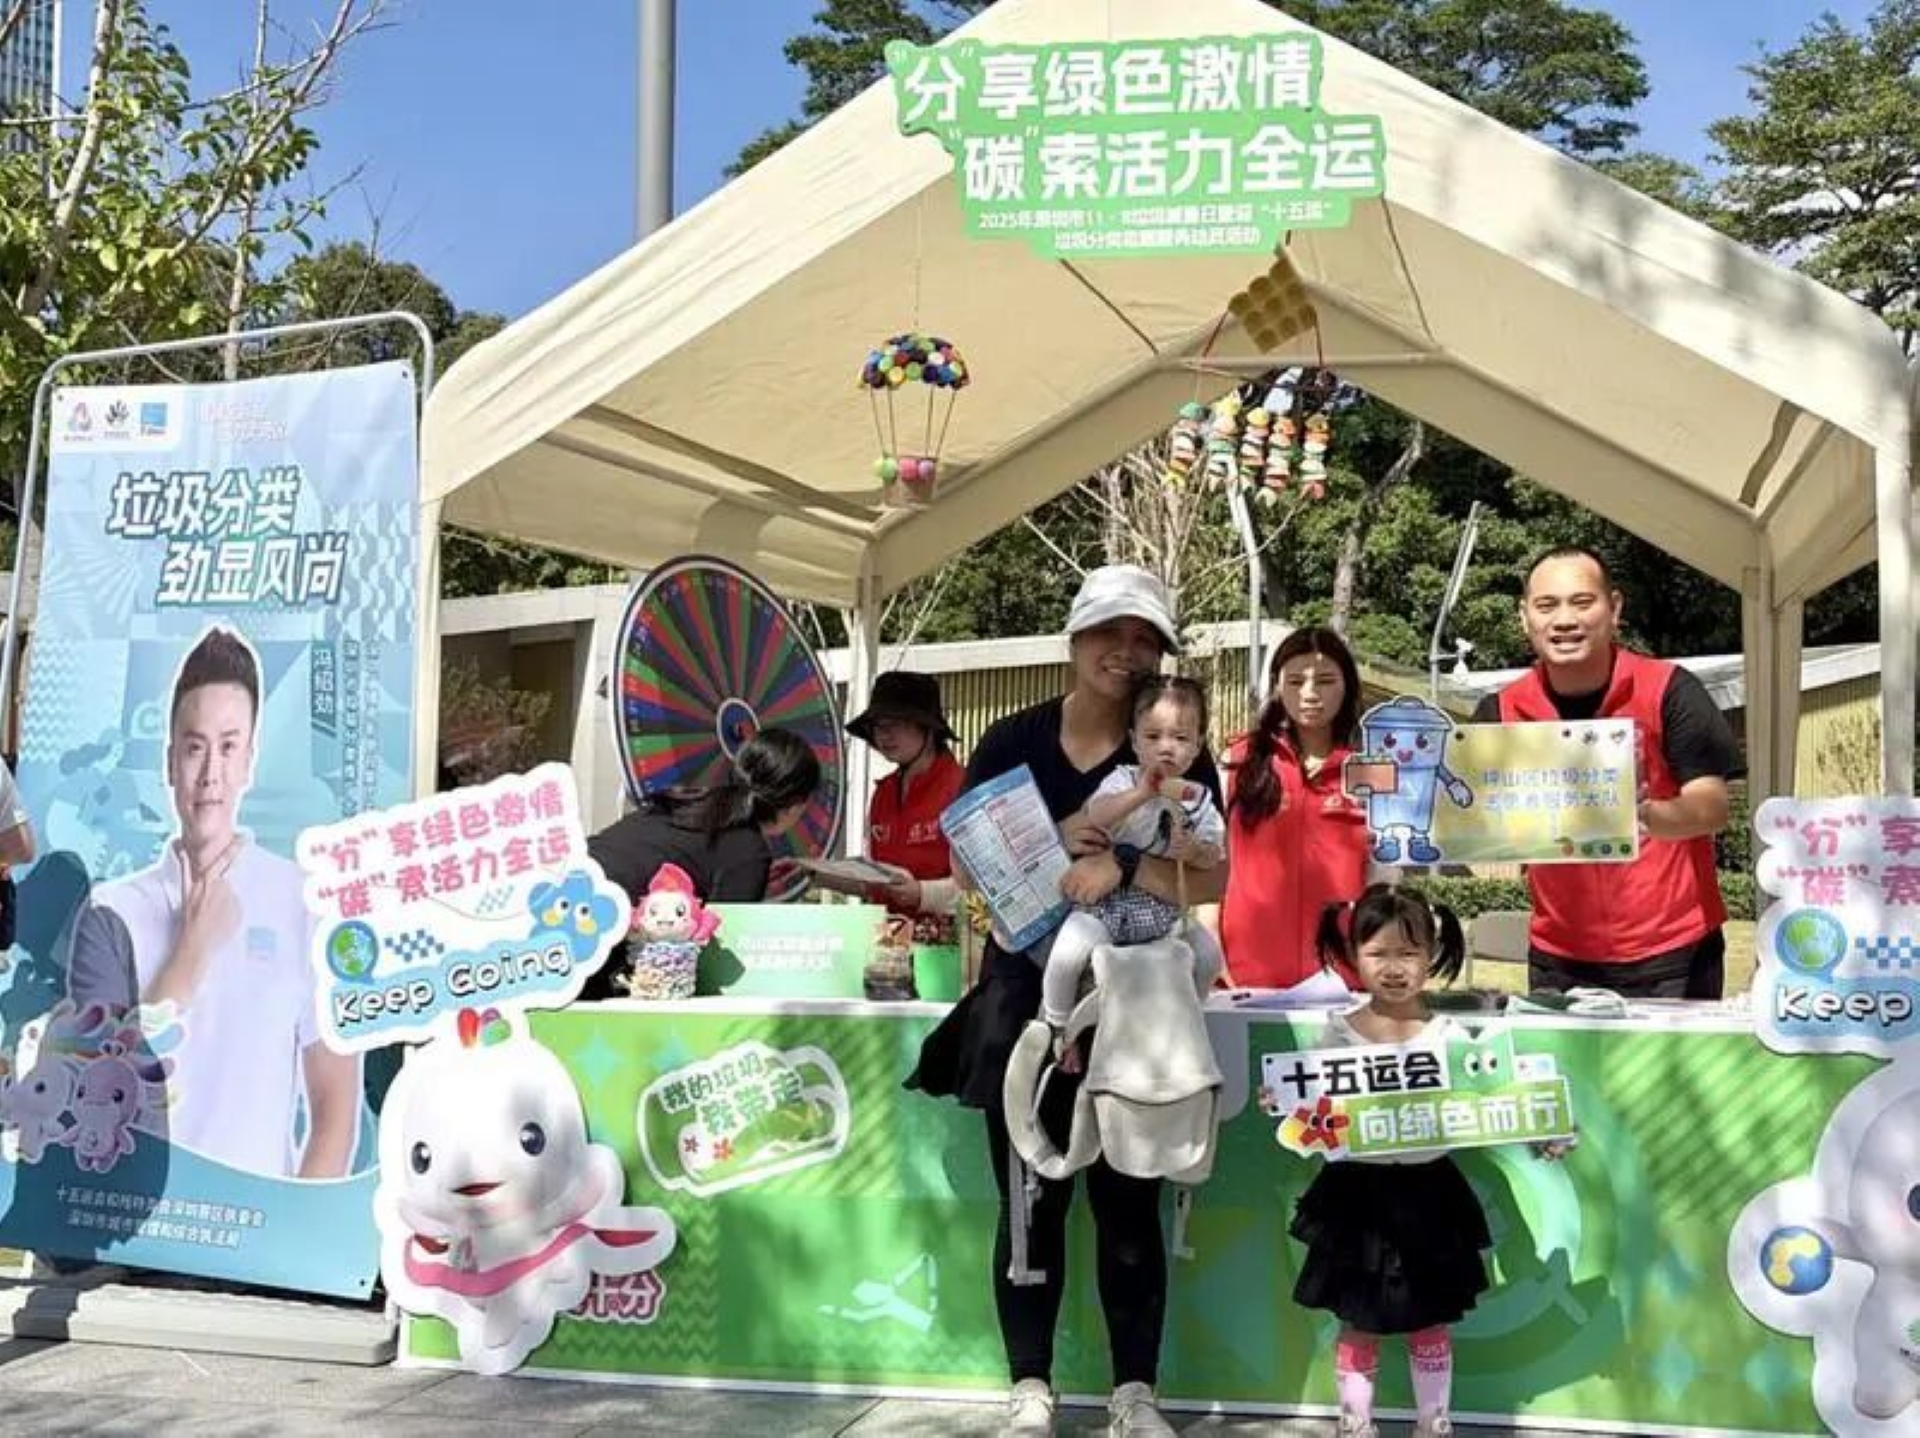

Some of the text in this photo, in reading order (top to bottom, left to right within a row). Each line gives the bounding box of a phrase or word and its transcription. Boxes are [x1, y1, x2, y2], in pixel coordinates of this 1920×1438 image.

[106, 466, 299, 538] 垃圾分类
[156, 532, 347, 605] 劲显风尚
[333, 943, 572, 1026] Keep Going
[1777, 986, 1913, 1026] Keep
[1281, 1051, 1443, 1099] 十五运会
[1357, 1091, 1559, 1145] 向绿色而行
